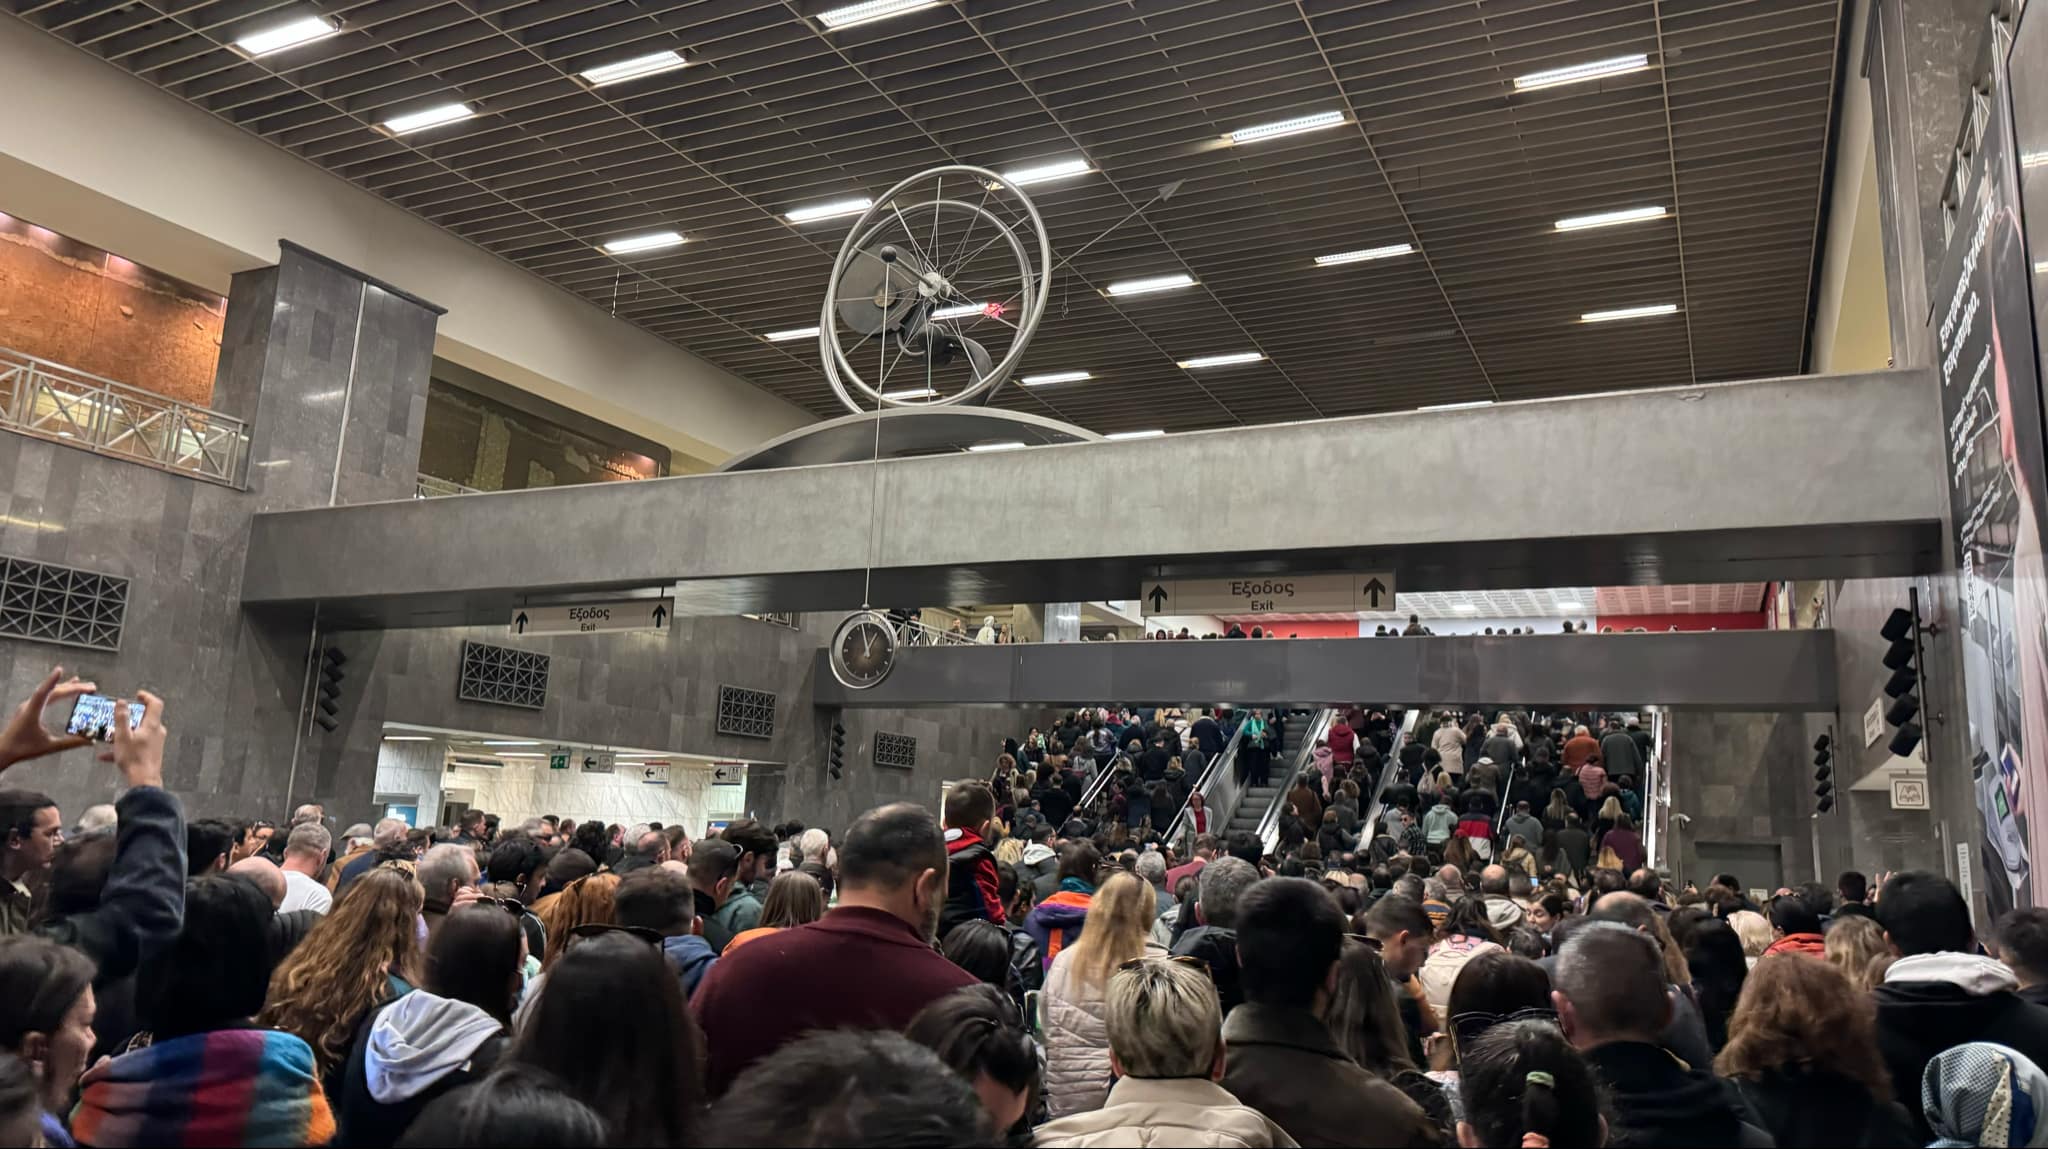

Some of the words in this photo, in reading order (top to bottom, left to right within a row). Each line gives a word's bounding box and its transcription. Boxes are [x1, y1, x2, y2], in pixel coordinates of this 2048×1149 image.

[1228, 580, 1294, 598] Έξοδος
[1251, 600, 1274, 611] Exit
[580, 623, 596, 632] Exit
